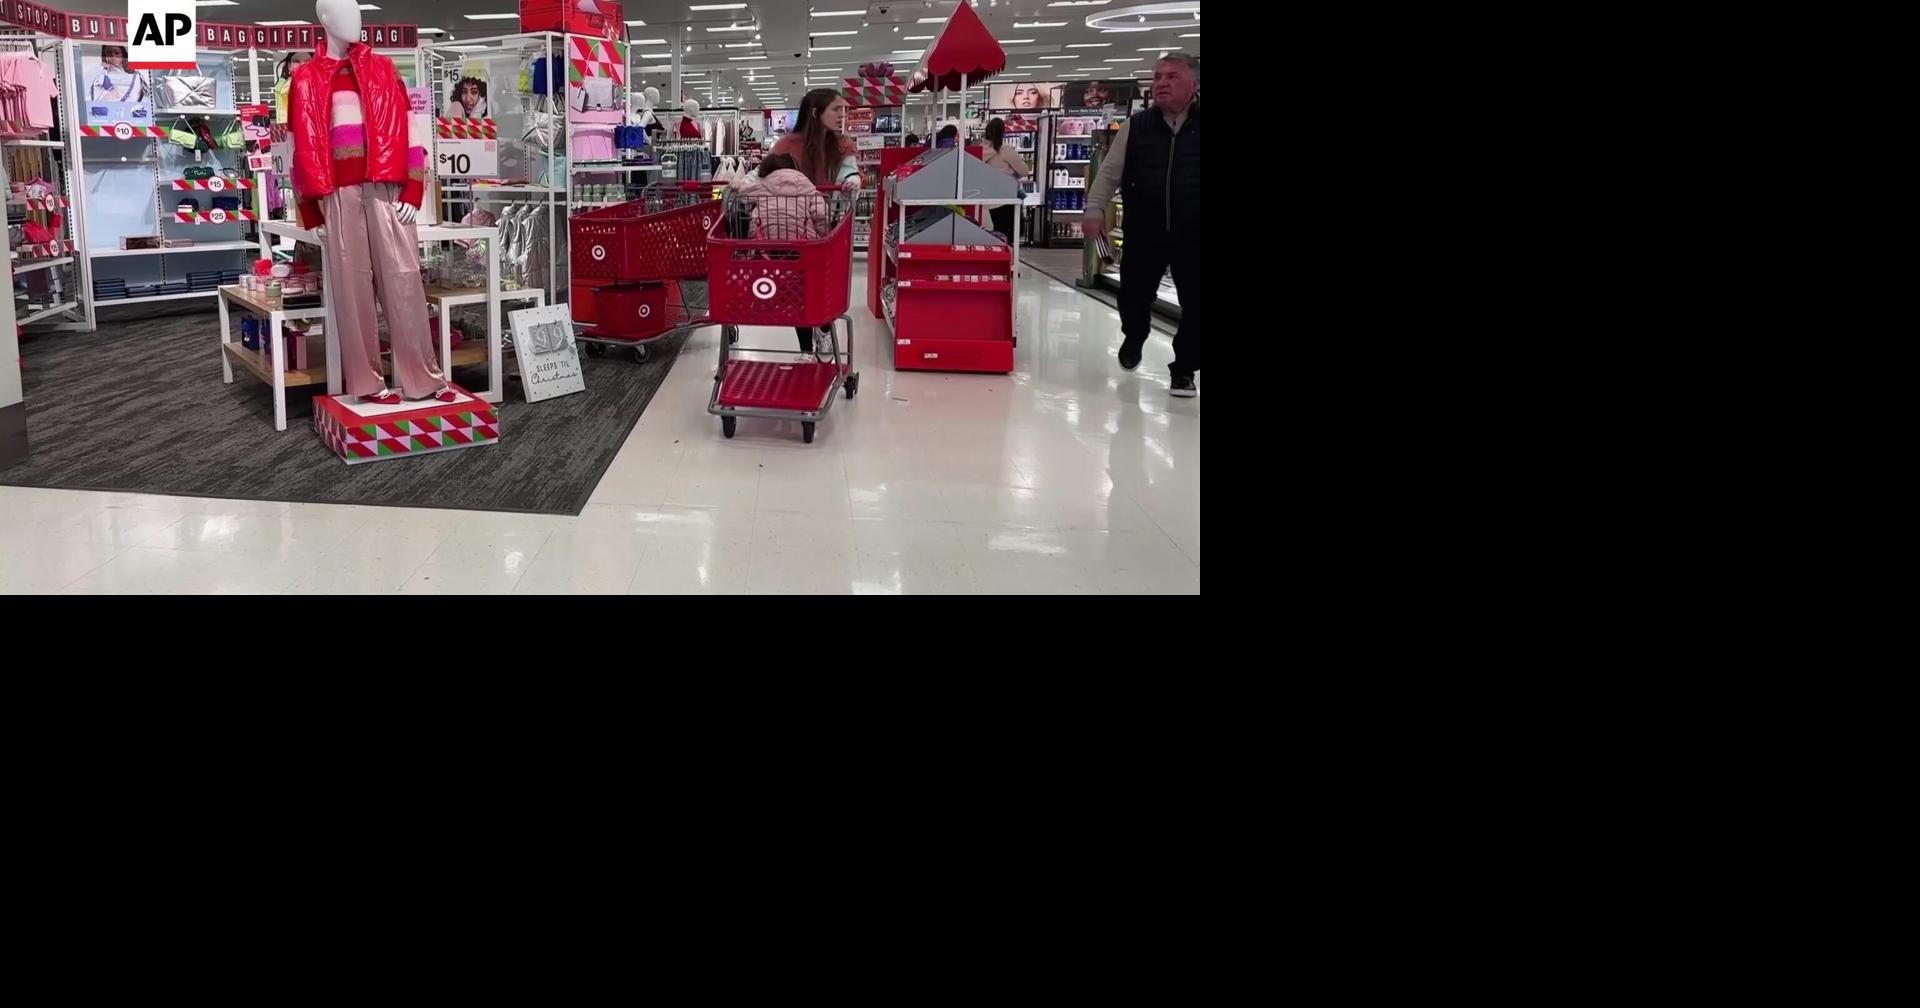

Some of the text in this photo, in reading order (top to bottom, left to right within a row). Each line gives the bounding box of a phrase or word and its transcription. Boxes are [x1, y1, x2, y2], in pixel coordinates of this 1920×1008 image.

[18, 4, 56, 27] STOP:
[72, 19, 128, 35] BUI
[444, 69, 459, 82] $15
[117, 127, 130, 136] $10
[440, 153, 471, 174] $10
[536, 361, 557, 373] SLEEPS
[531, 370, 578, 385] Christmas
